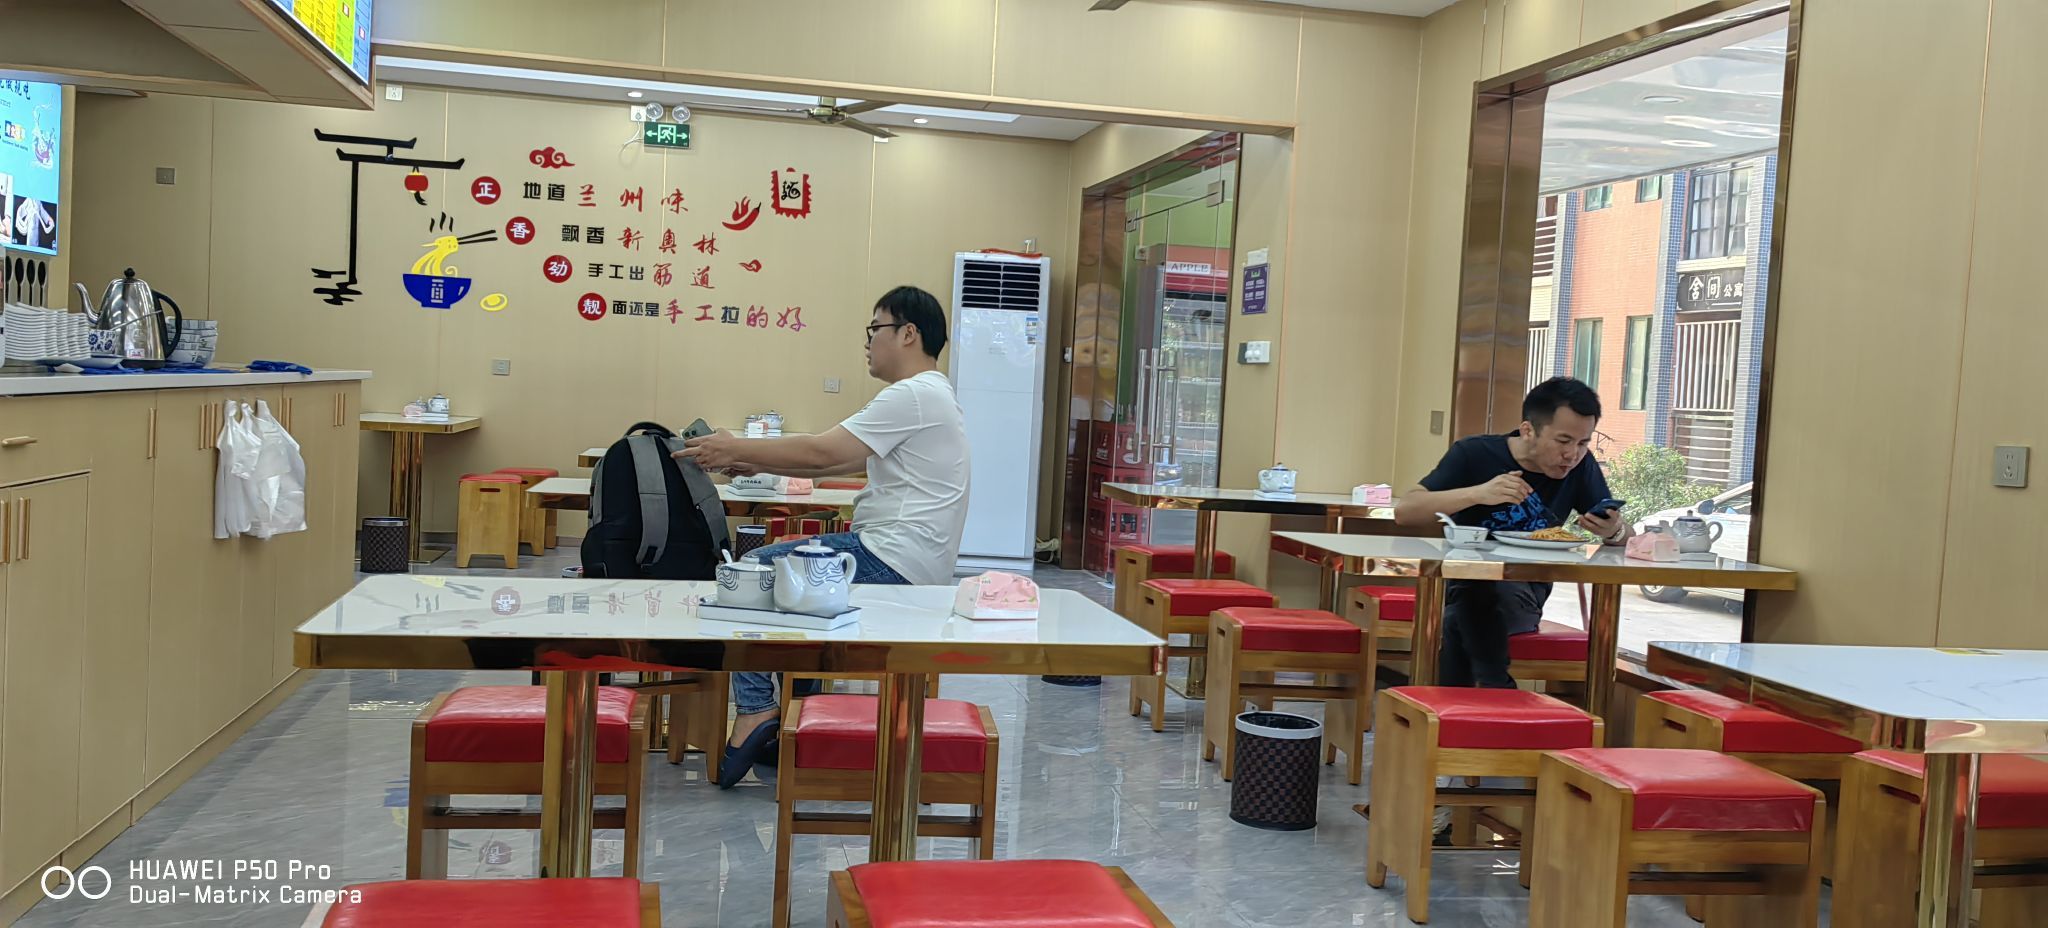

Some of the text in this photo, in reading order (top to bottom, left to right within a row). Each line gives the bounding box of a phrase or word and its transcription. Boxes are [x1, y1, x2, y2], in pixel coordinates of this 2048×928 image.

[475, 181, 497, 200] 正
[509, 221, 531, 240] 香
[547, 260, 569, 277] 劲
[582, 298, 602, 316] 靓
